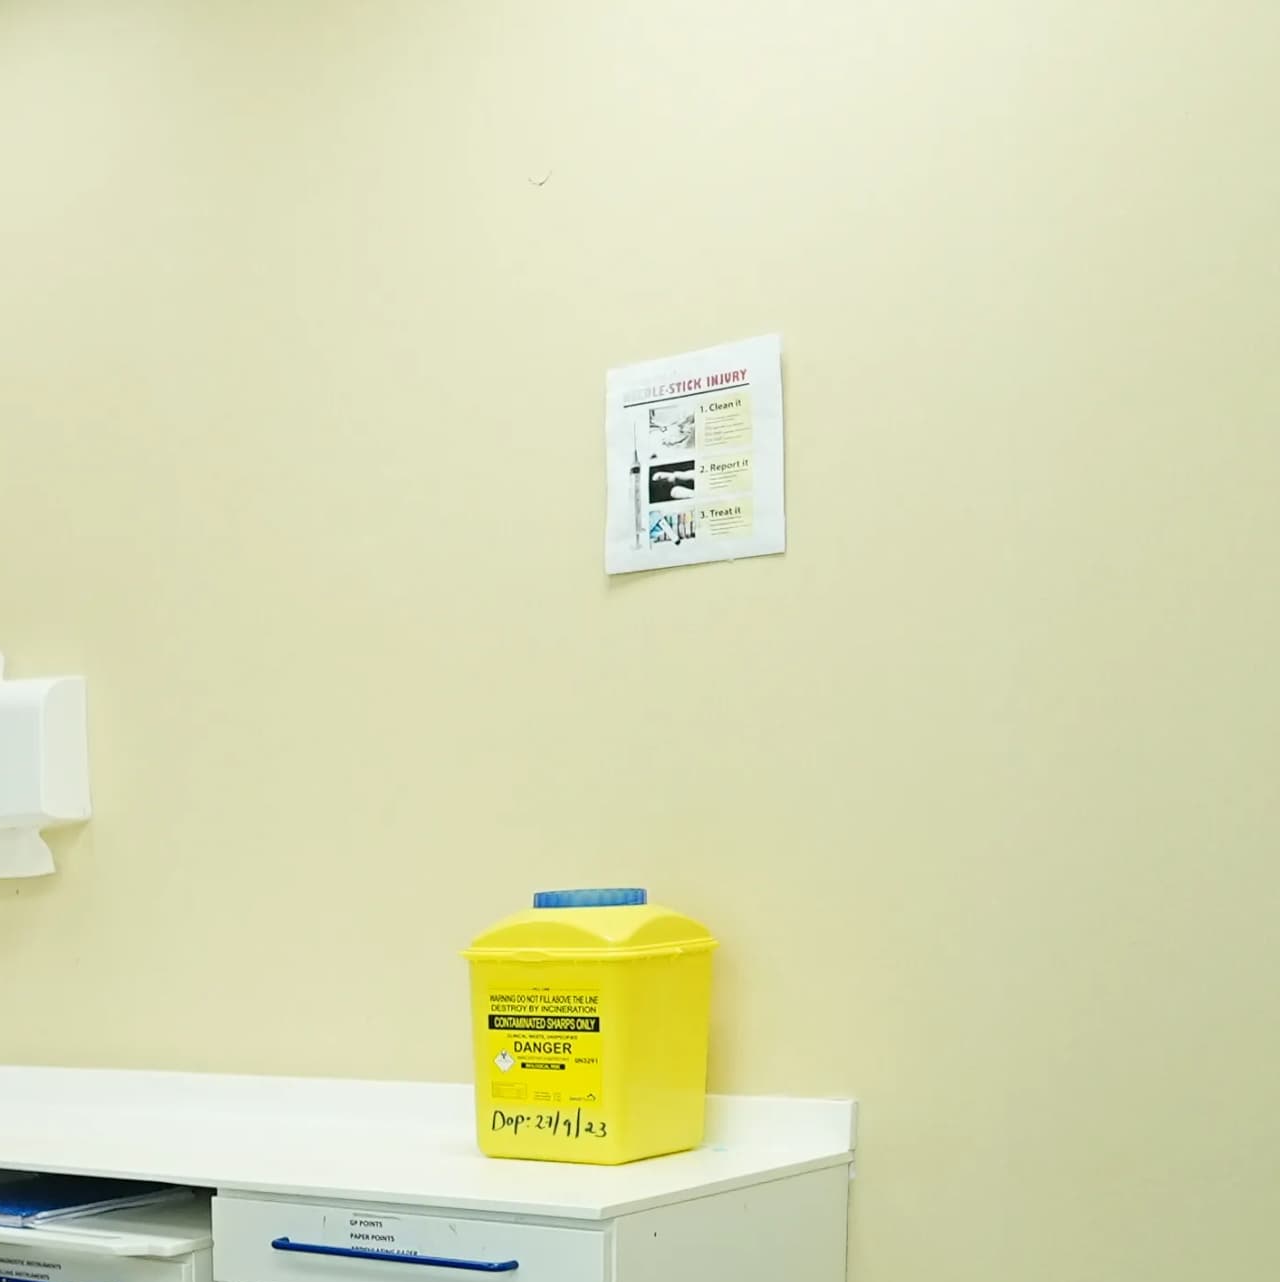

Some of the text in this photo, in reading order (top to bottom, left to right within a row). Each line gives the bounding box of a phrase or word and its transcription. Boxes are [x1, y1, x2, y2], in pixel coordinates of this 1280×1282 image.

[707, 369, 747, 388] INJURY
[709, 401, 733, 412] Clean
[735, 399, 742, 407] it
[710, 460, 740, 472] Report
[710, 508, 732, 518] Treat
[735, 506, 741, 514] it
[490, 995, 599, 1004] WARNING DO NOT FILL ABOVE THE LINE
[491, 1004, 597, 1014] DESTROY BY INCINERATION
[494, 1016, 596, 1031] CONTAMINATED SHARPS ONLY
[514, 1041, 572, 1054] DANGER
[371, 1234, 395, 1242] POINTS
